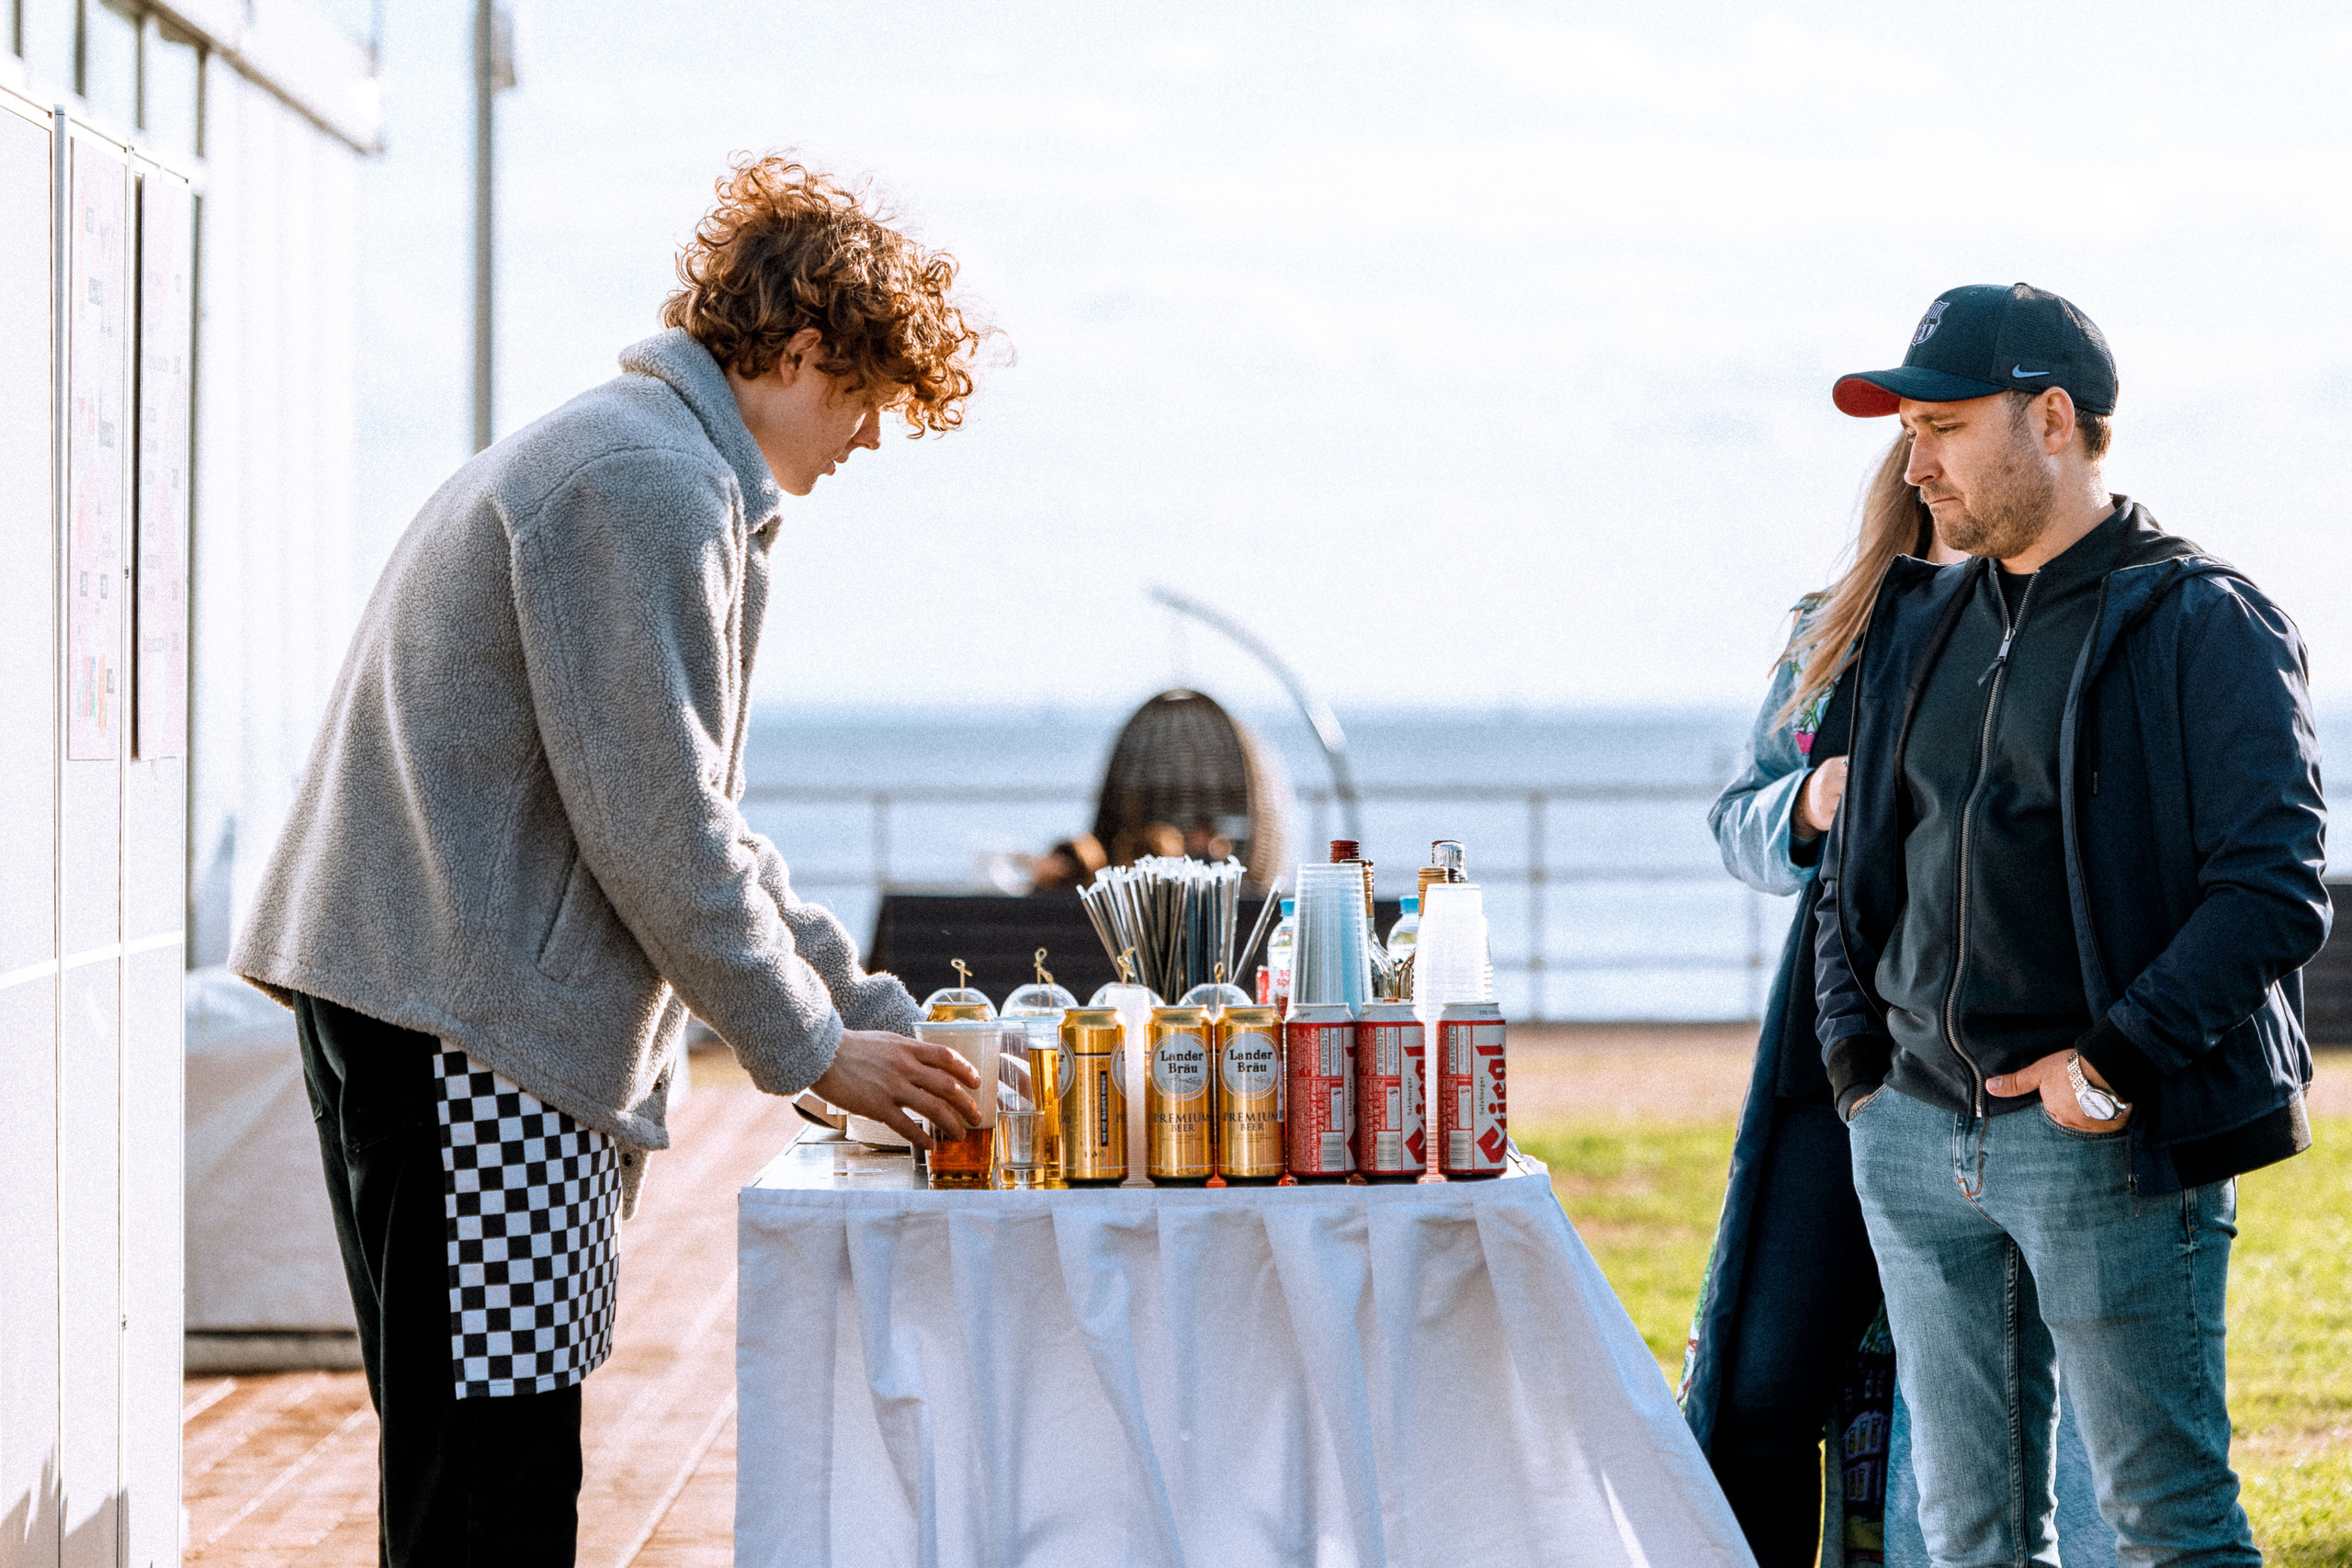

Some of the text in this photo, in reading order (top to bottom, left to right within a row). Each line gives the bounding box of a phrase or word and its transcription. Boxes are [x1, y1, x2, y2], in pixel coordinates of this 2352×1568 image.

[1160, 1050, 1204, 1061] Lander
[1229, 1049, 1272, 1060] Lander
[1168, 1063, 1198, 1074] Bräu
[1237, 1062, 1267, 1073] Bräu
[1154, 1111, 1211, 1123] PREMIUM
[1223, 1111, 1278, 1122] PREMIUM
[1171, 1123, 1195, 1132] BEER
[1240, 1122, 1264, 1131] BEER
